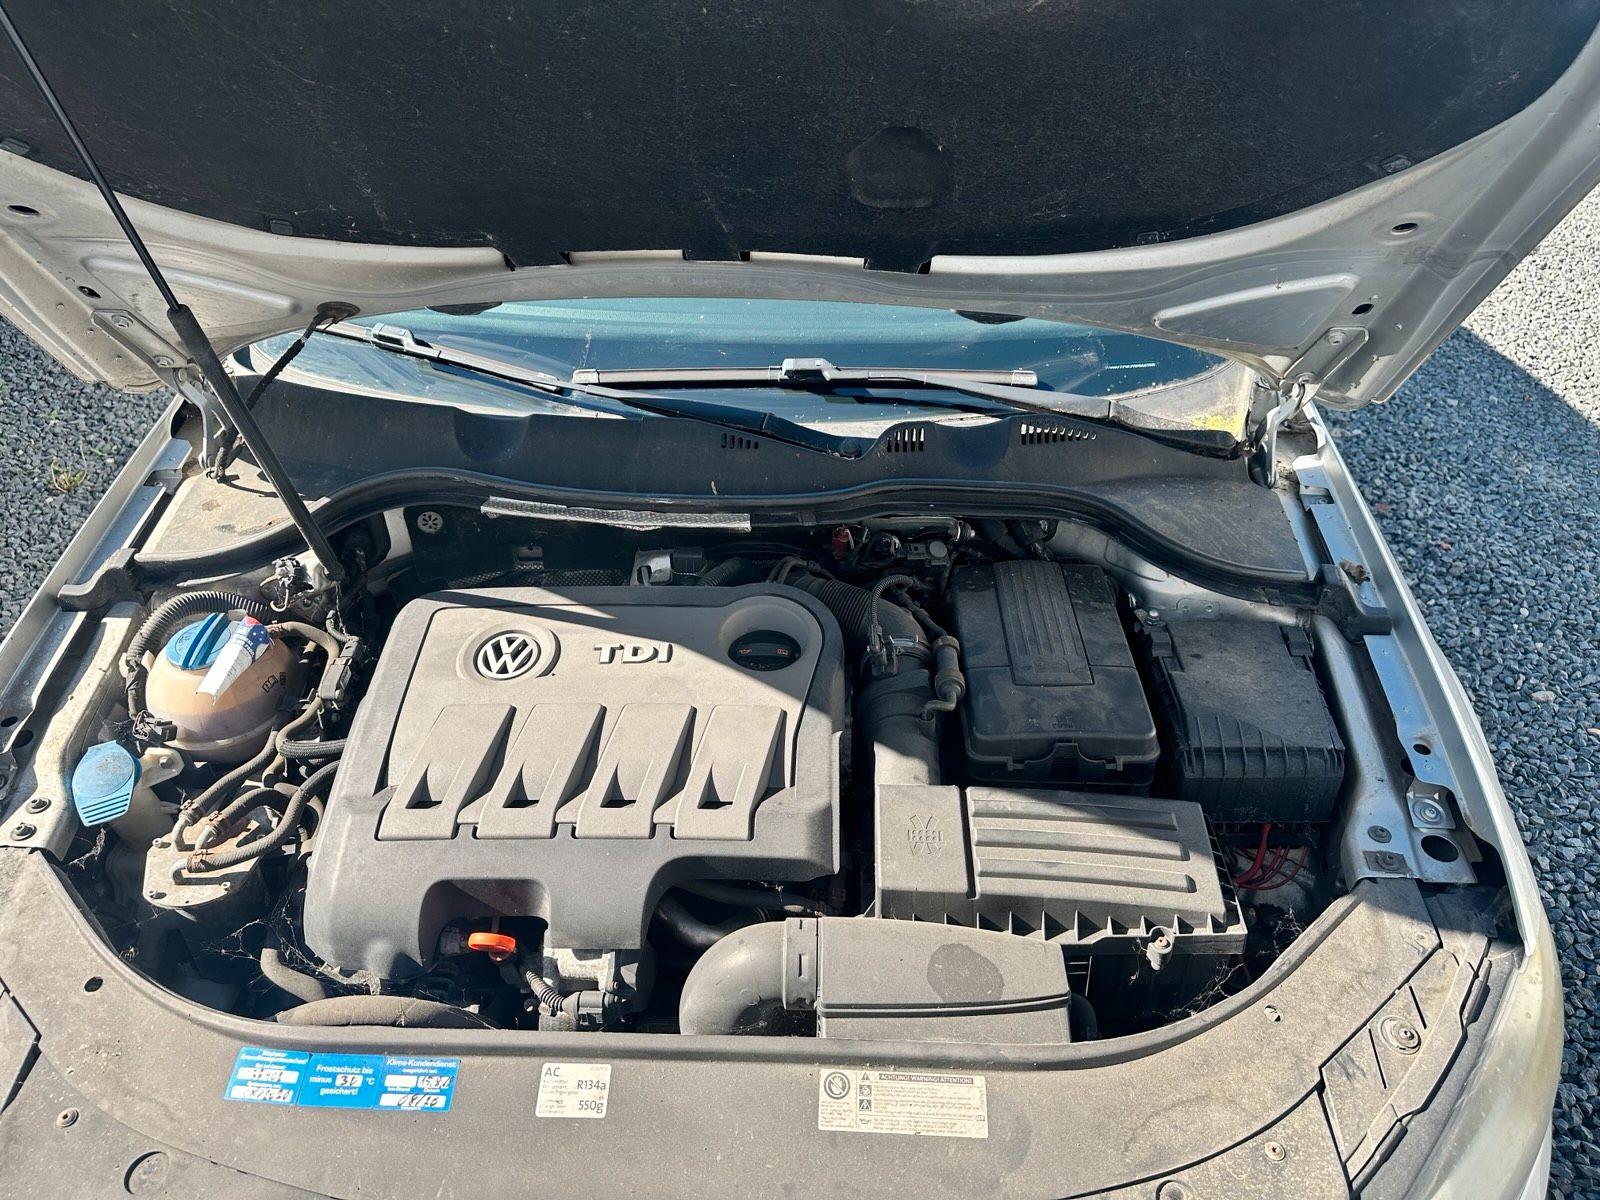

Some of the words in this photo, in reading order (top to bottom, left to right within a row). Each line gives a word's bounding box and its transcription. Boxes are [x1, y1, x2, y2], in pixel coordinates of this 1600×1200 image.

[477, 633, 537, 680] VW
[594, 643, 673, 664] TDI
[386, 1058, 457, 1068] Klima-Kundendienst
[316, 1064, 360, 1074] Frostschutz
[361, 1067, 374, 1075] bis
[545, 1067, 560, 1077] AC
[309, 1075, 333, 1083] minus
[577, 1080, 607, 1091] R134a
[320, 1087, 359, 1096] gesichert!
[578, 1100, 604, 1114] 550g
